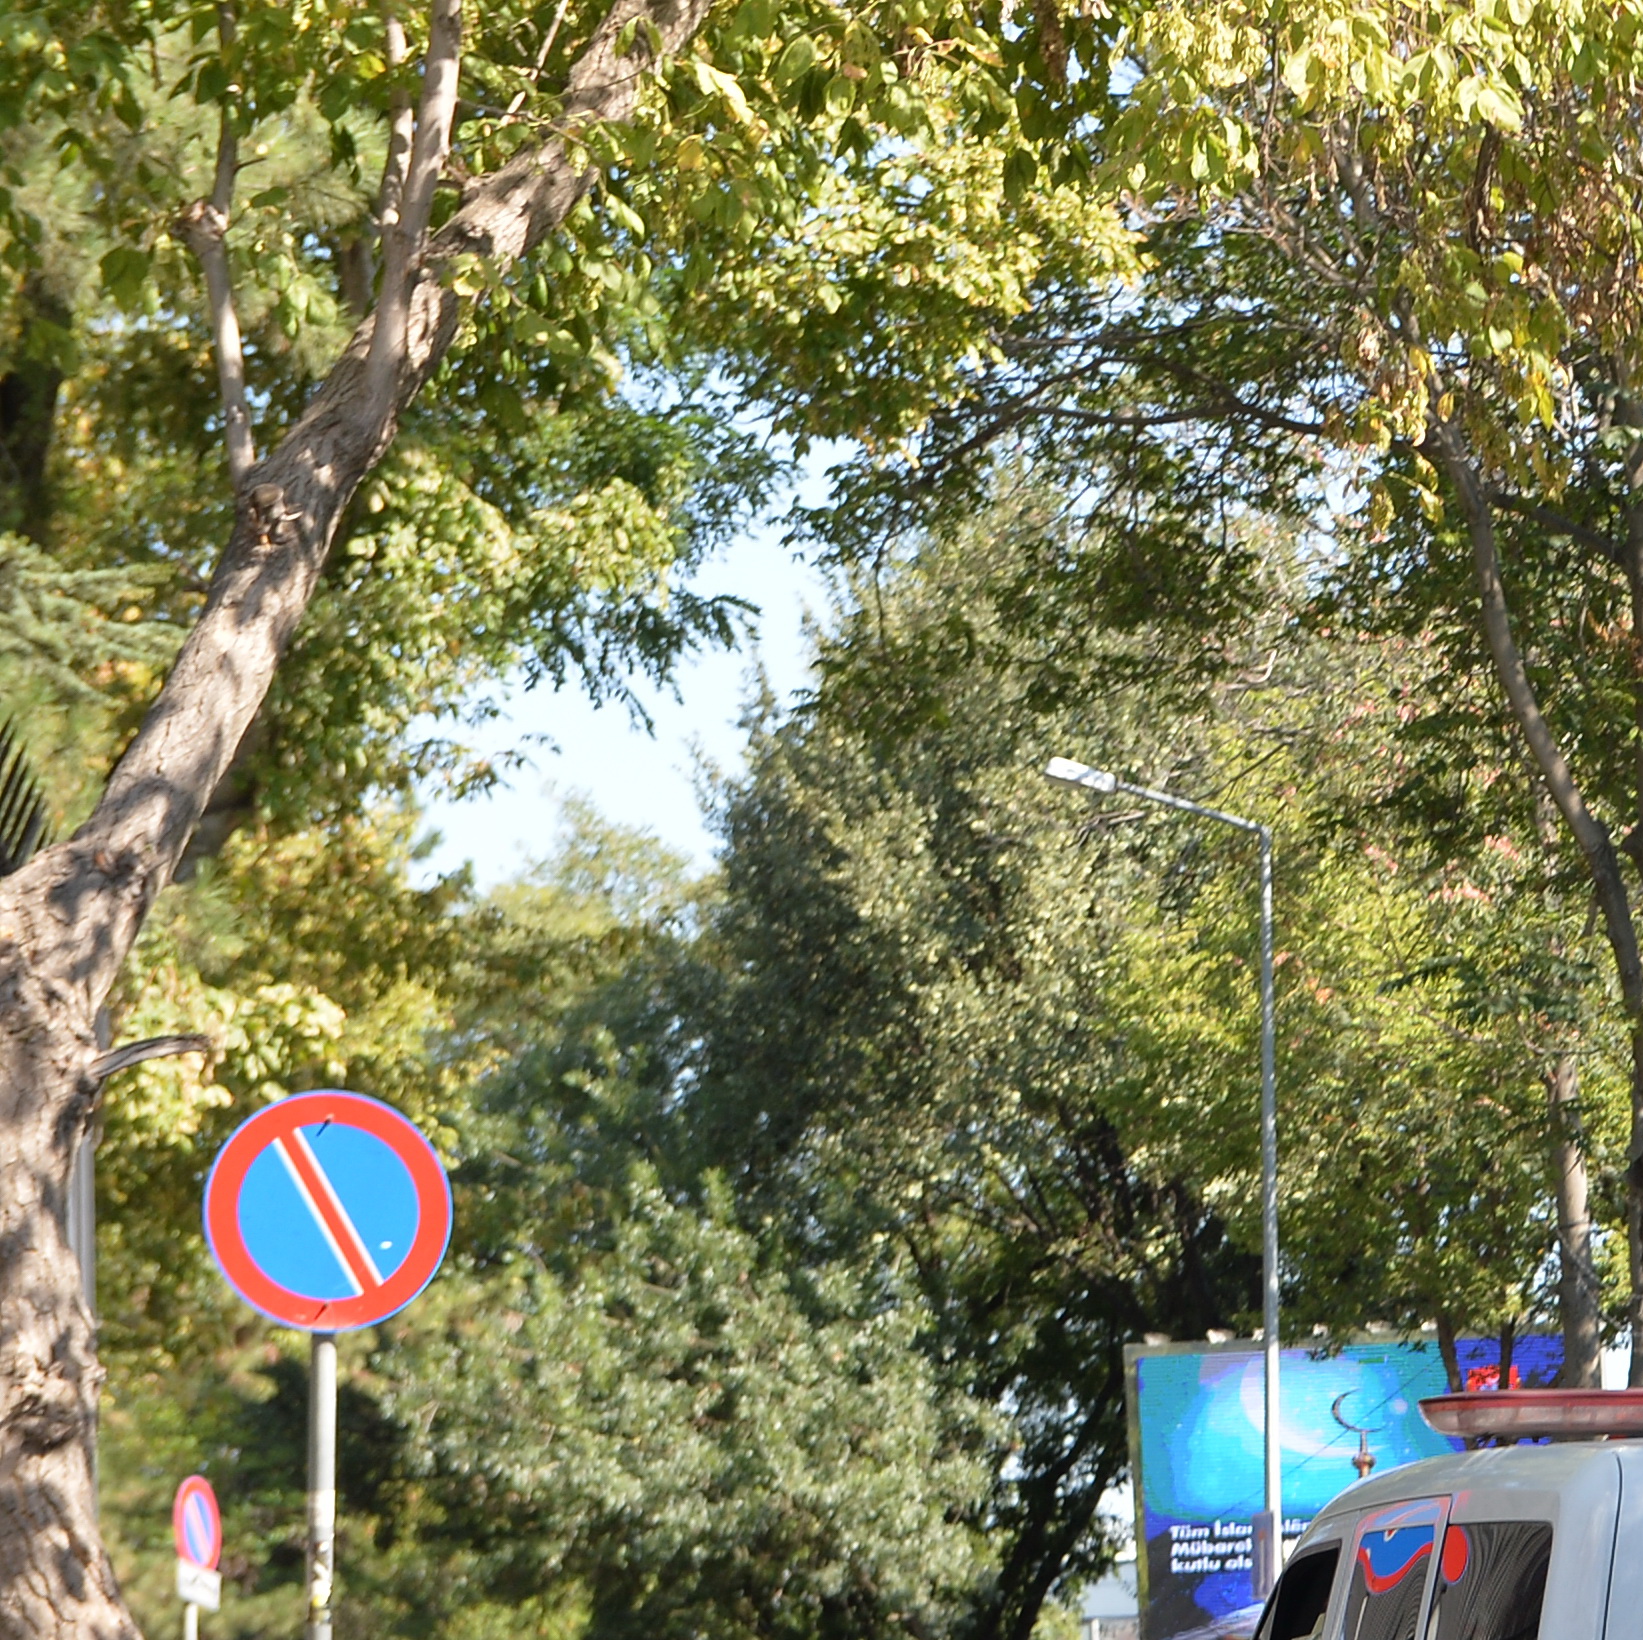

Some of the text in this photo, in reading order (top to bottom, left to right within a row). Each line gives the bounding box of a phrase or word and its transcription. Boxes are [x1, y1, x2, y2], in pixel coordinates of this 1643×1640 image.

[1169, 1523, 1211, 1541] Tüm
[1170, 1555, 1254, 1575] kutlu ols
